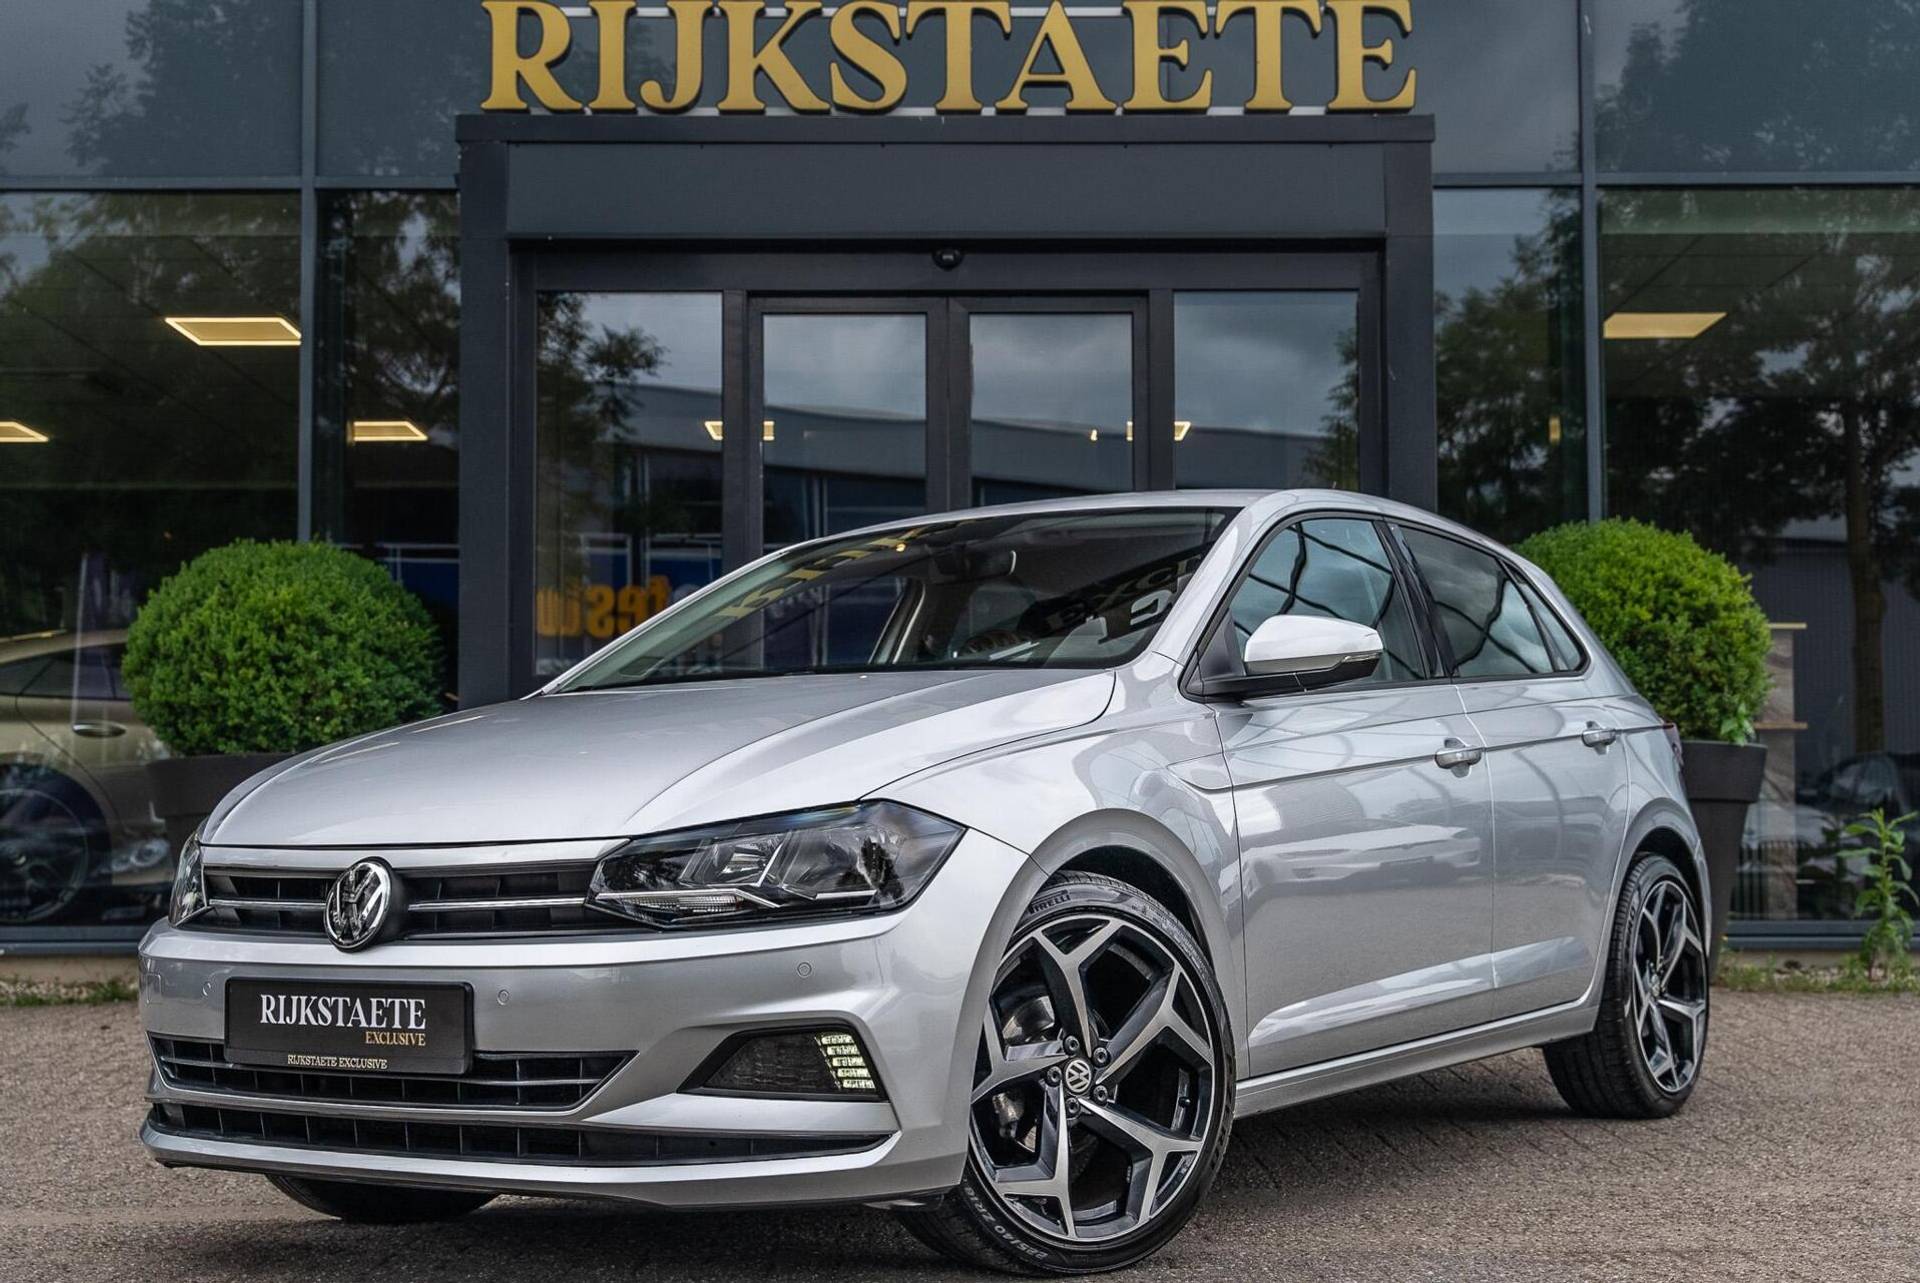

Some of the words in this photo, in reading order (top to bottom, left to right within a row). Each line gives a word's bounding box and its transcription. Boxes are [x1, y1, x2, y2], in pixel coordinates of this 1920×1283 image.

[481, 0, 1417, 112] RIJKSTAETE
[260, 994, 426, 1029] RIJKSTAETE
[365, 1031, 426, 1046] EXCLUSIVE
[287, 1054, 338, 1067] RIJKSTAETE
[339, 1057, 388, 1069] EXCLUSIVE
